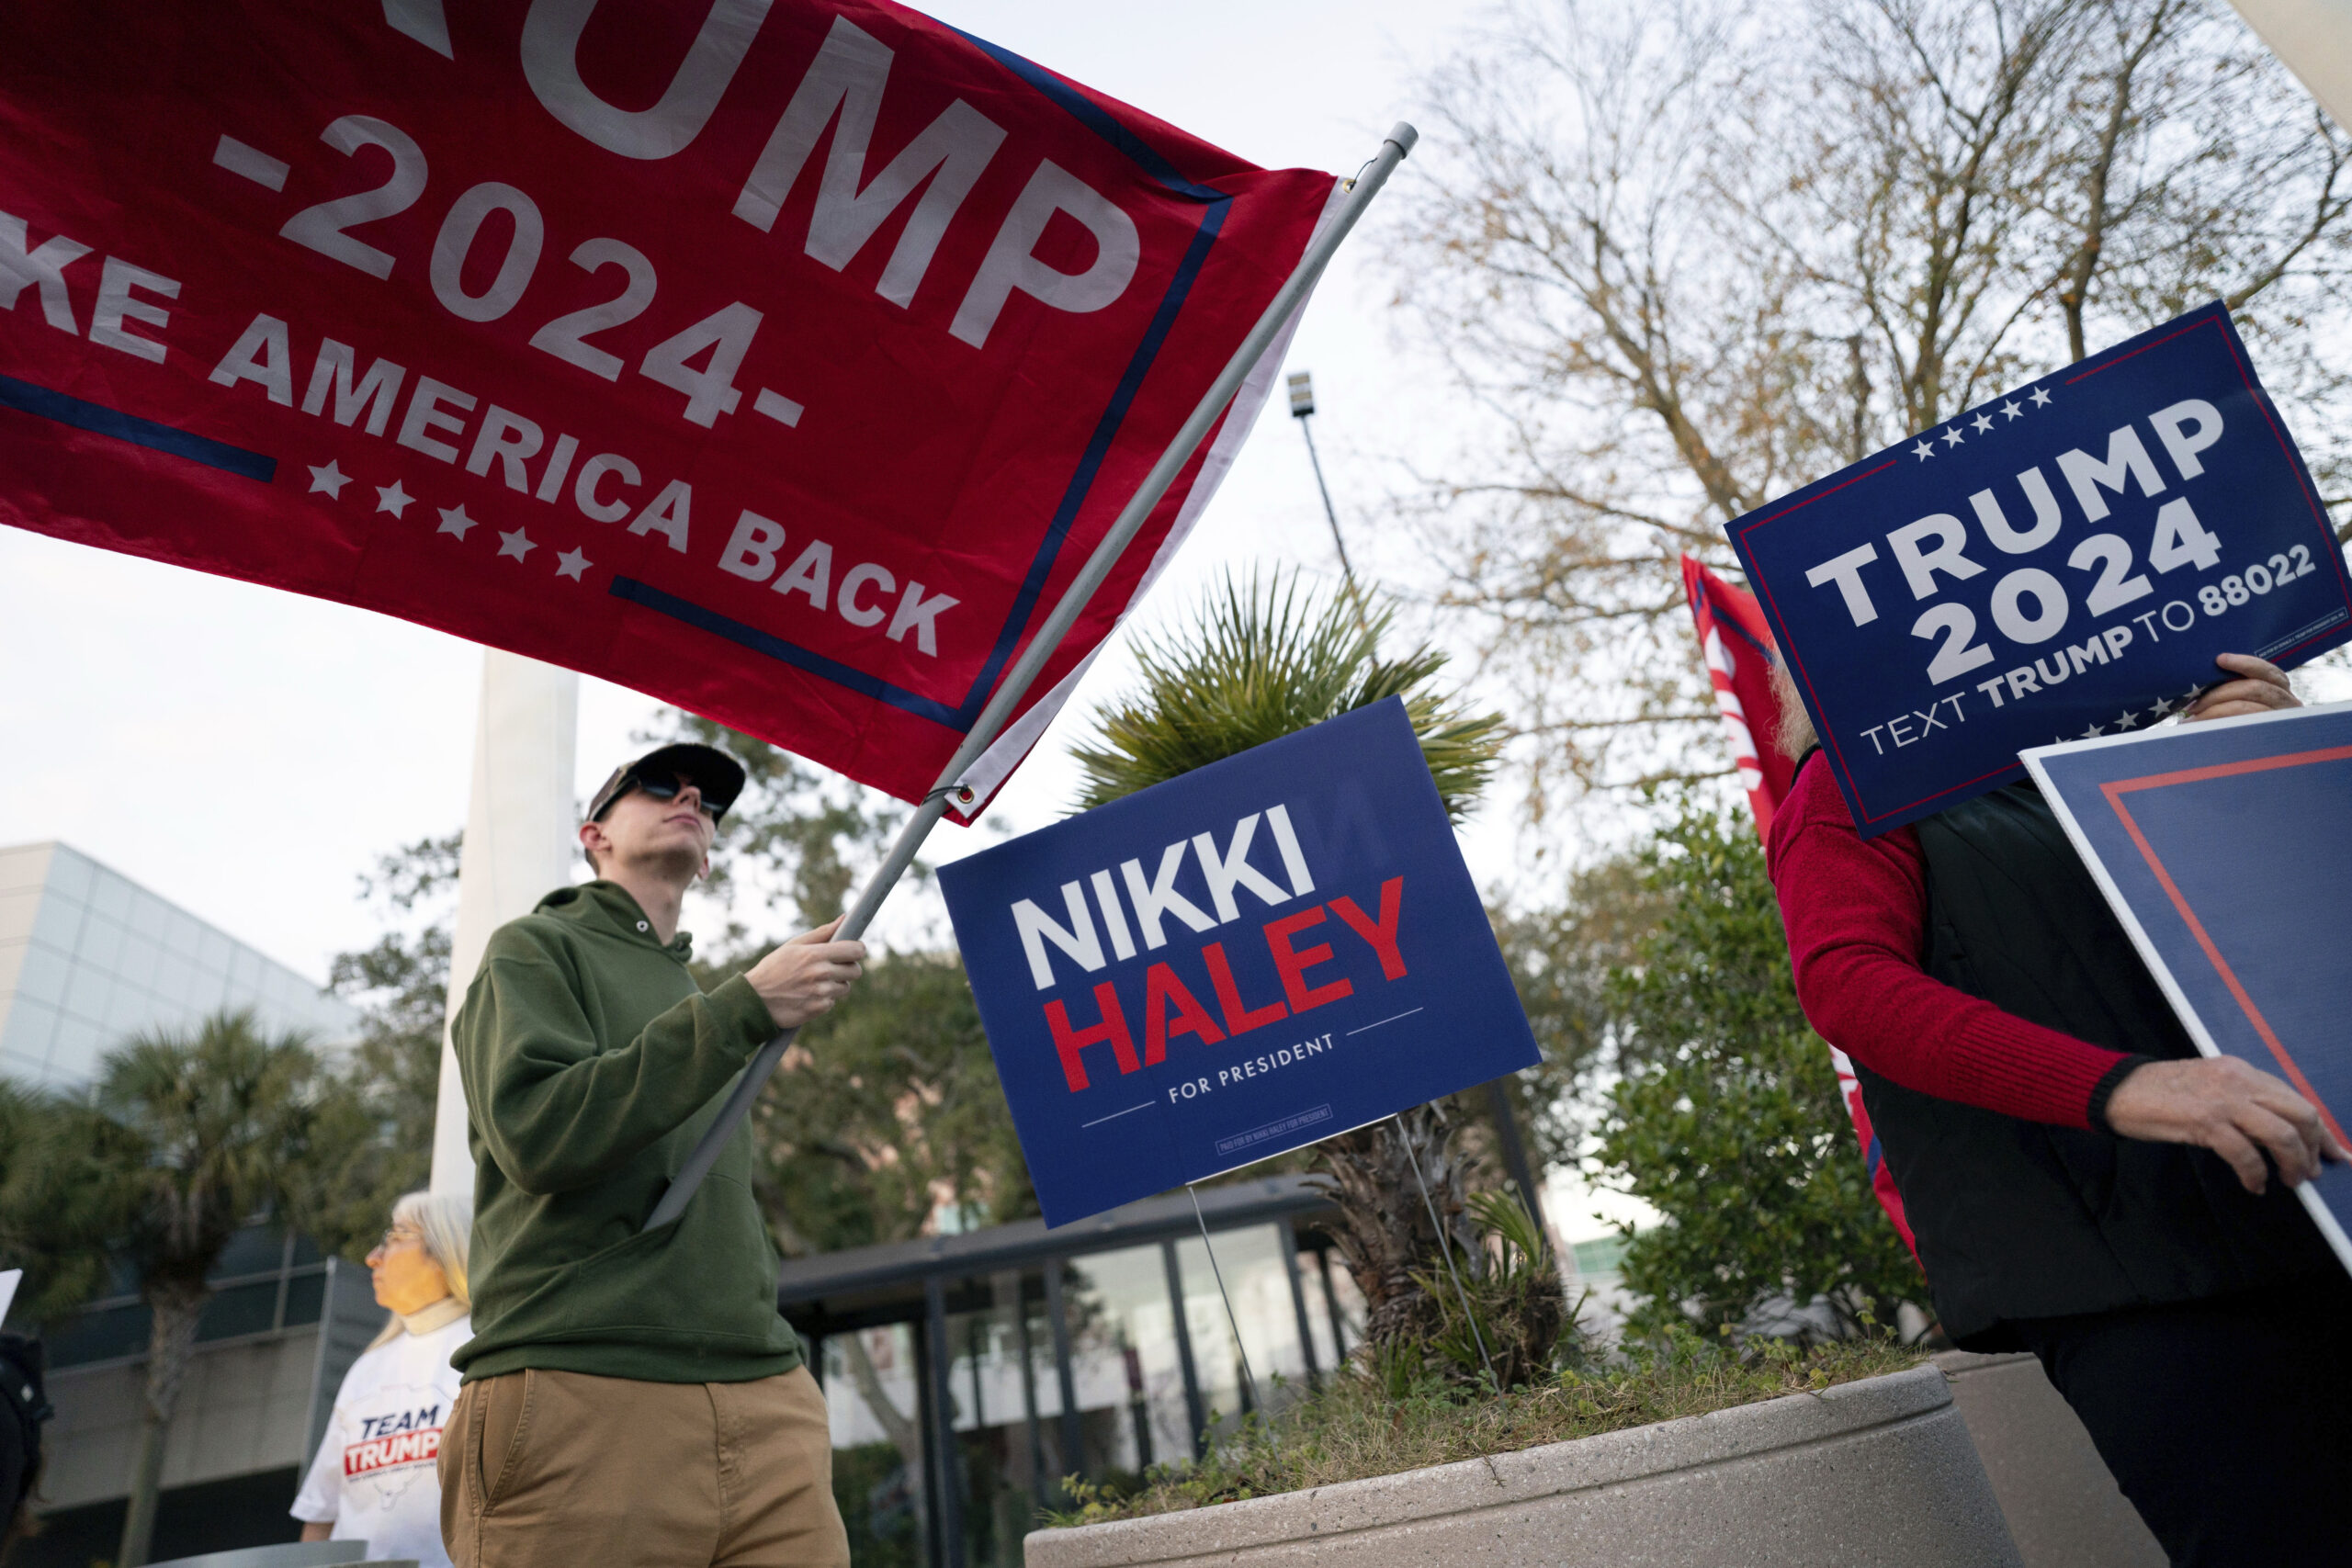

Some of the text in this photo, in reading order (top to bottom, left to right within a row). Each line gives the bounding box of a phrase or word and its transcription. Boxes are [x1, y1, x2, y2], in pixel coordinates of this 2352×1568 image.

[212, 114, 805, 429] -2024-
[383, 0, 1140, 350] UMP
[208, 312, 692, 554] AMERICA
[717, 509, 961, 658] BACK
[1804, 399, 2224, 627] TRUMP
[1860, 692, 1966, 756] TEXT
[1977, 626, 2133, 708] TRUMP
[2132, 600, 2195, 642] TO
[2198, 544, 2316, 617] 88022
[1911, 497, 2222, 686] 2024
[1010, 803, 1317, 991] NIKKI
[1043, 875, 1408, 1094] HALEY
[1169, 1033, 1333, 1104] FOR PRESIDENT
[346, 1431, 441, 1472] TRUMP
[361, 1404, 439, 1439] TEAM
